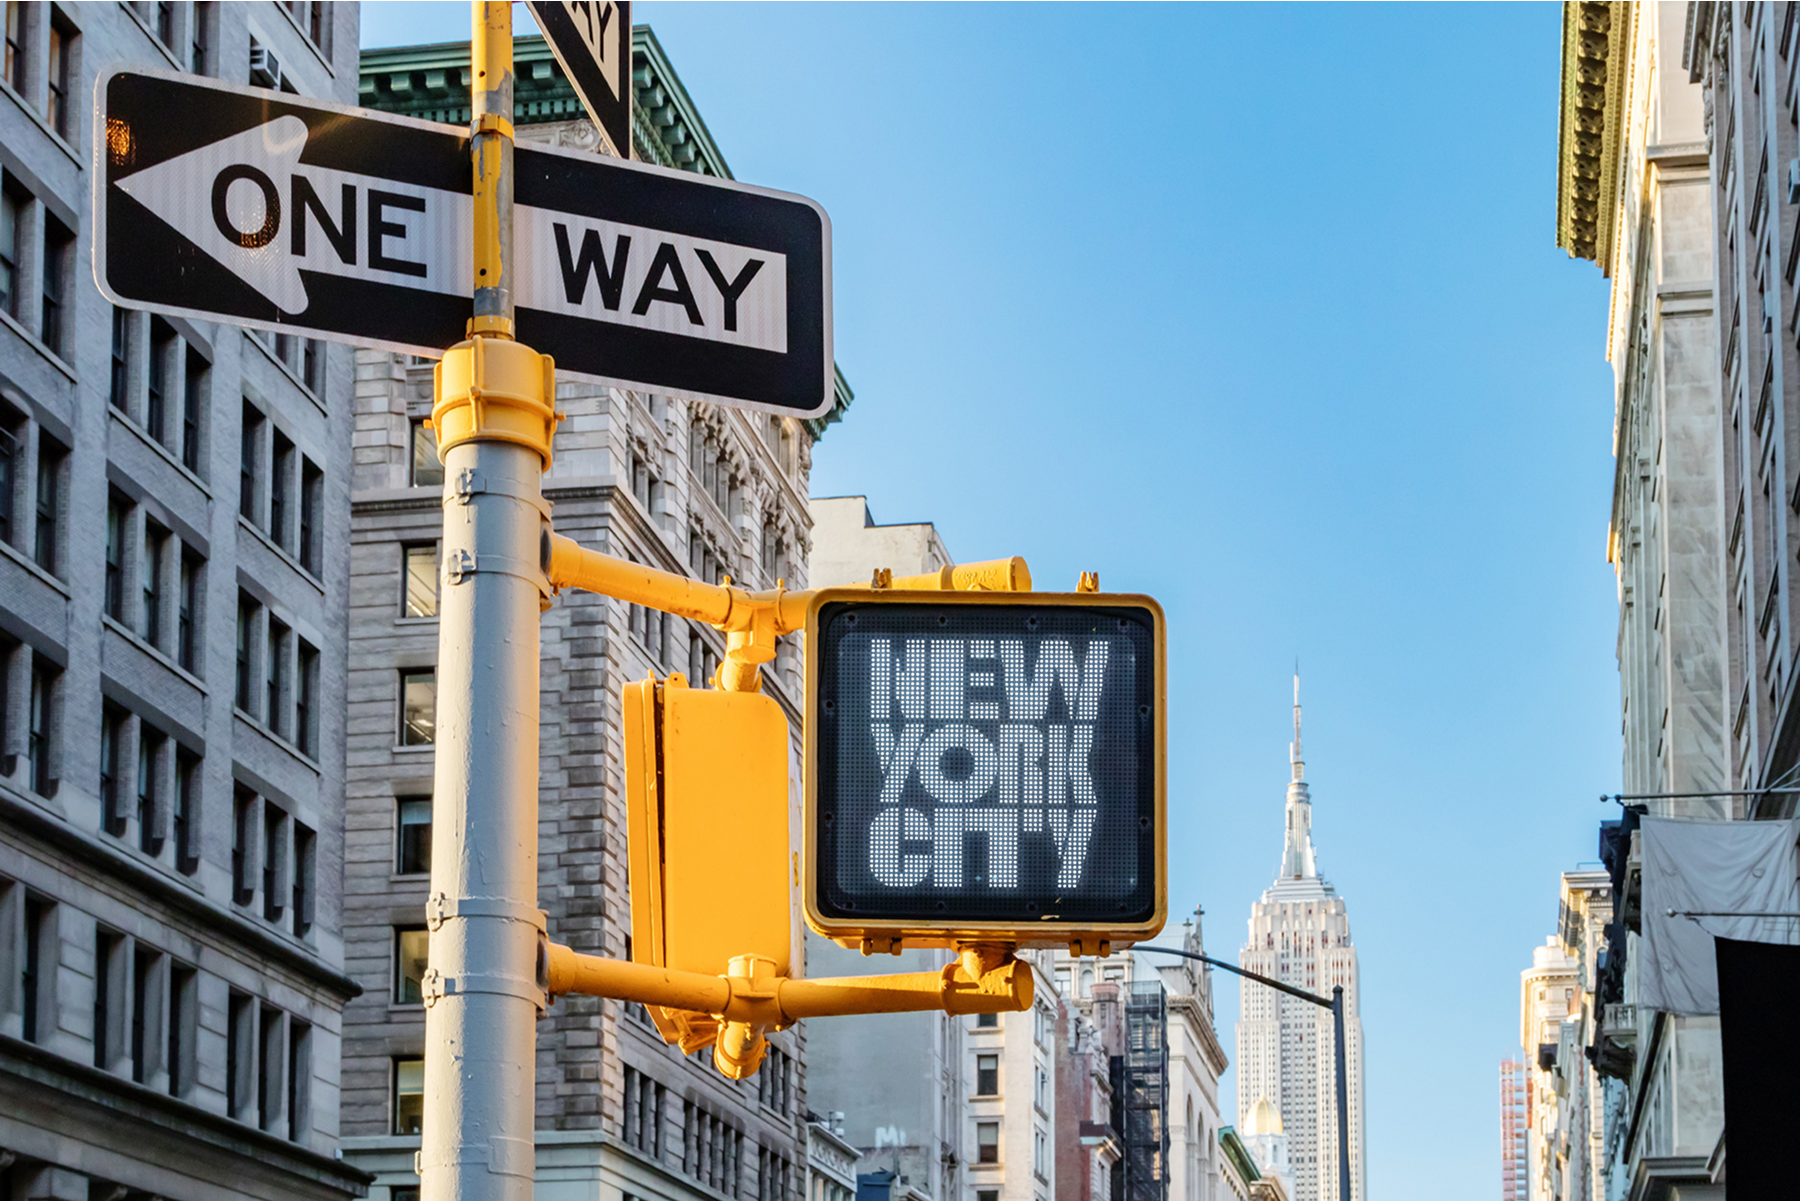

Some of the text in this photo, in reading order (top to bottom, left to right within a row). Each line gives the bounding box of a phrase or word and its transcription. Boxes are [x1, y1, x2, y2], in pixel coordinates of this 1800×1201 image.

[212, 164, 765, 332] ONE WAY
[870, 638, 1110, 720] NEW
[870, 722, 1097, 804] YORK
[869, 806, 1097, 888] CITY
